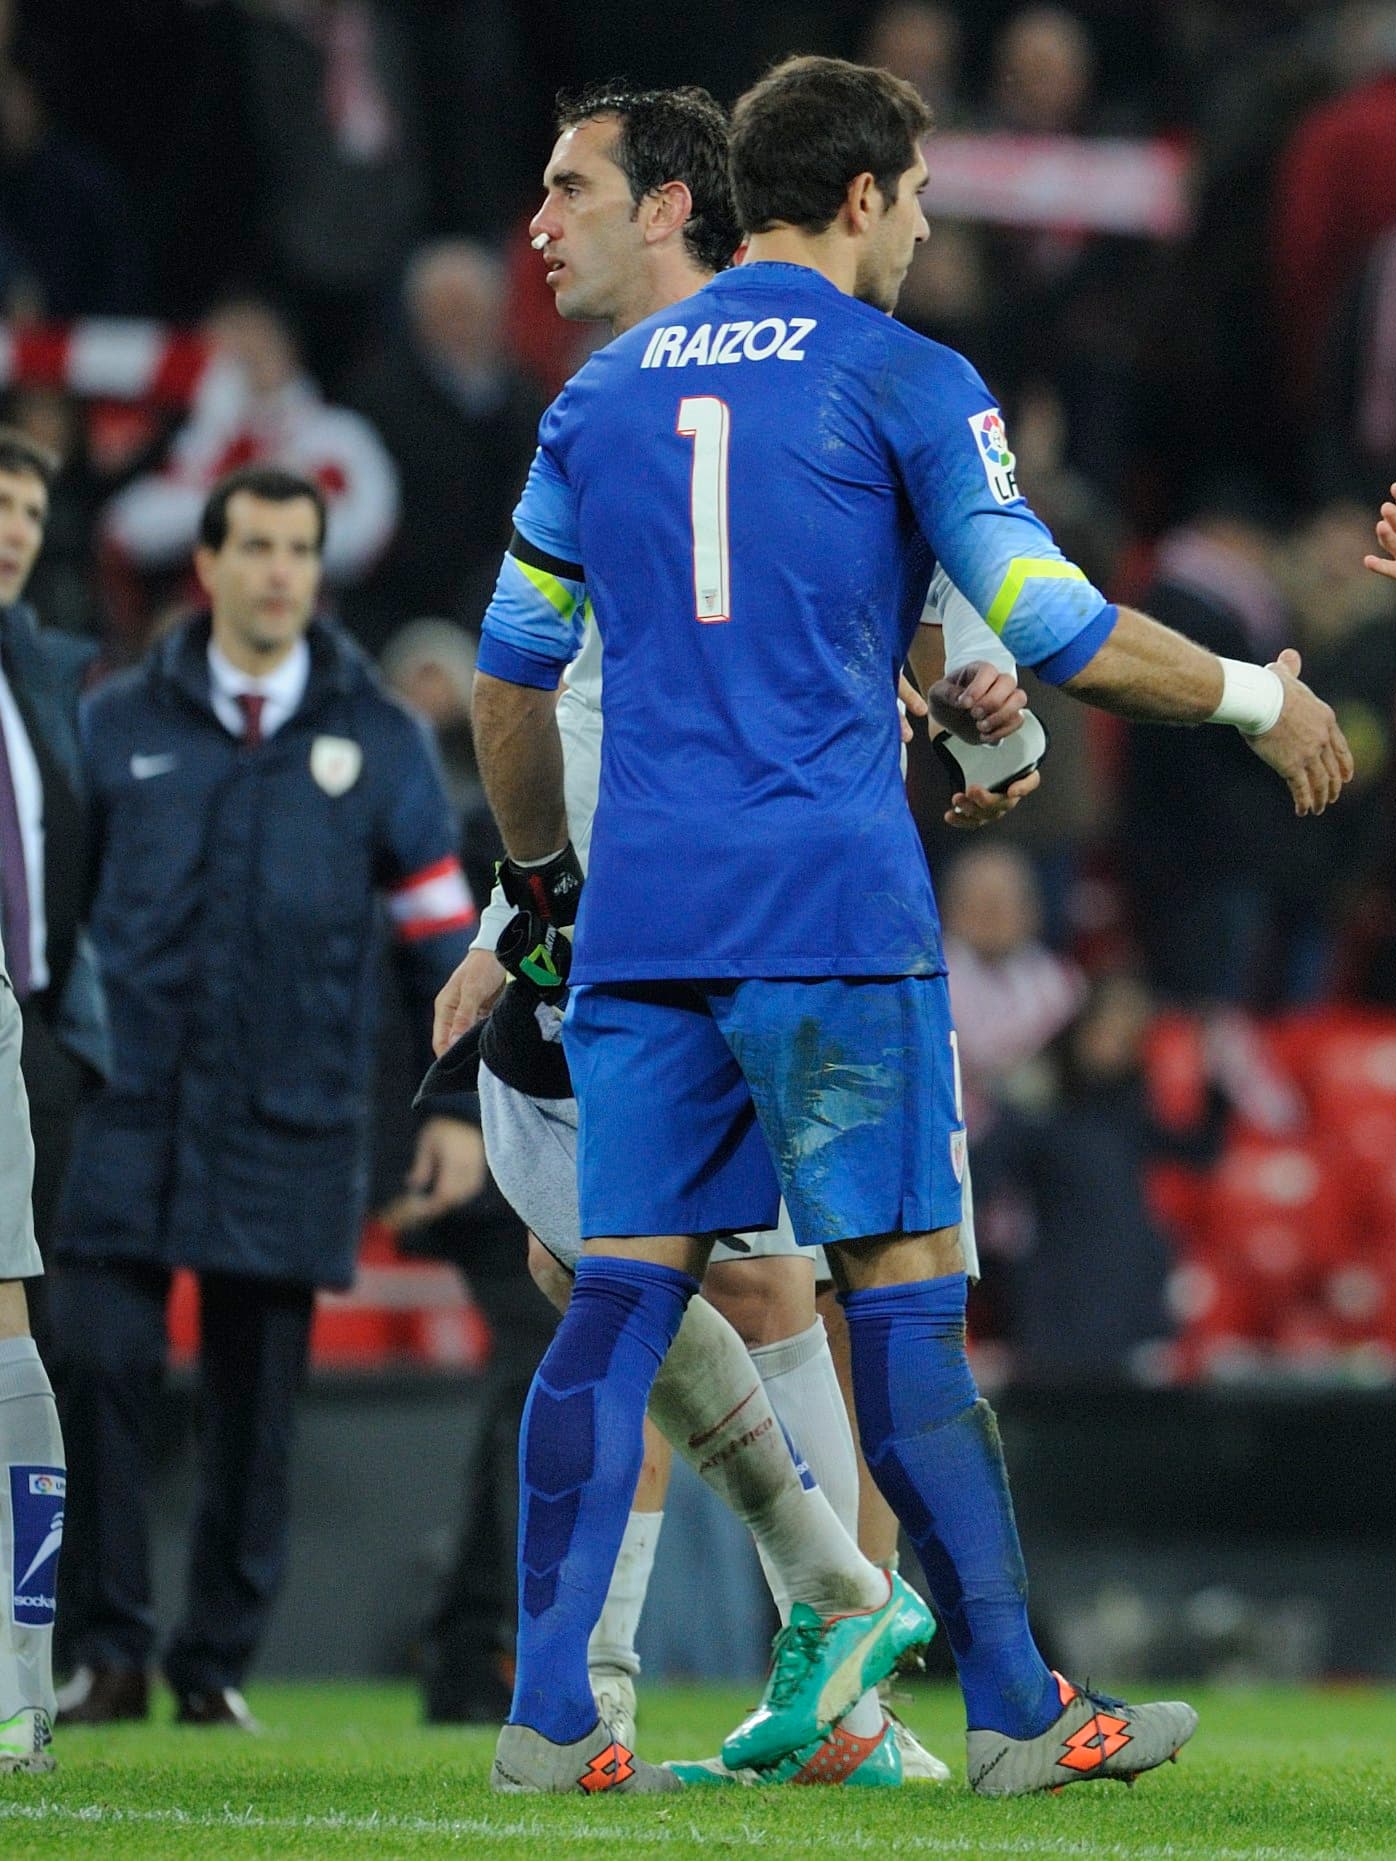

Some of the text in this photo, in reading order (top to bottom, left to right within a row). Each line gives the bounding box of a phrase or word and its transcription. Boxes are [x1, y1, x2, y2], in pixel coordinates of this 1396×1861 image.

[641, 317, 817, 369] IRAIZOZ
[676, 395, 731, 623] 1
[994, 471, 1017, 500] LF
